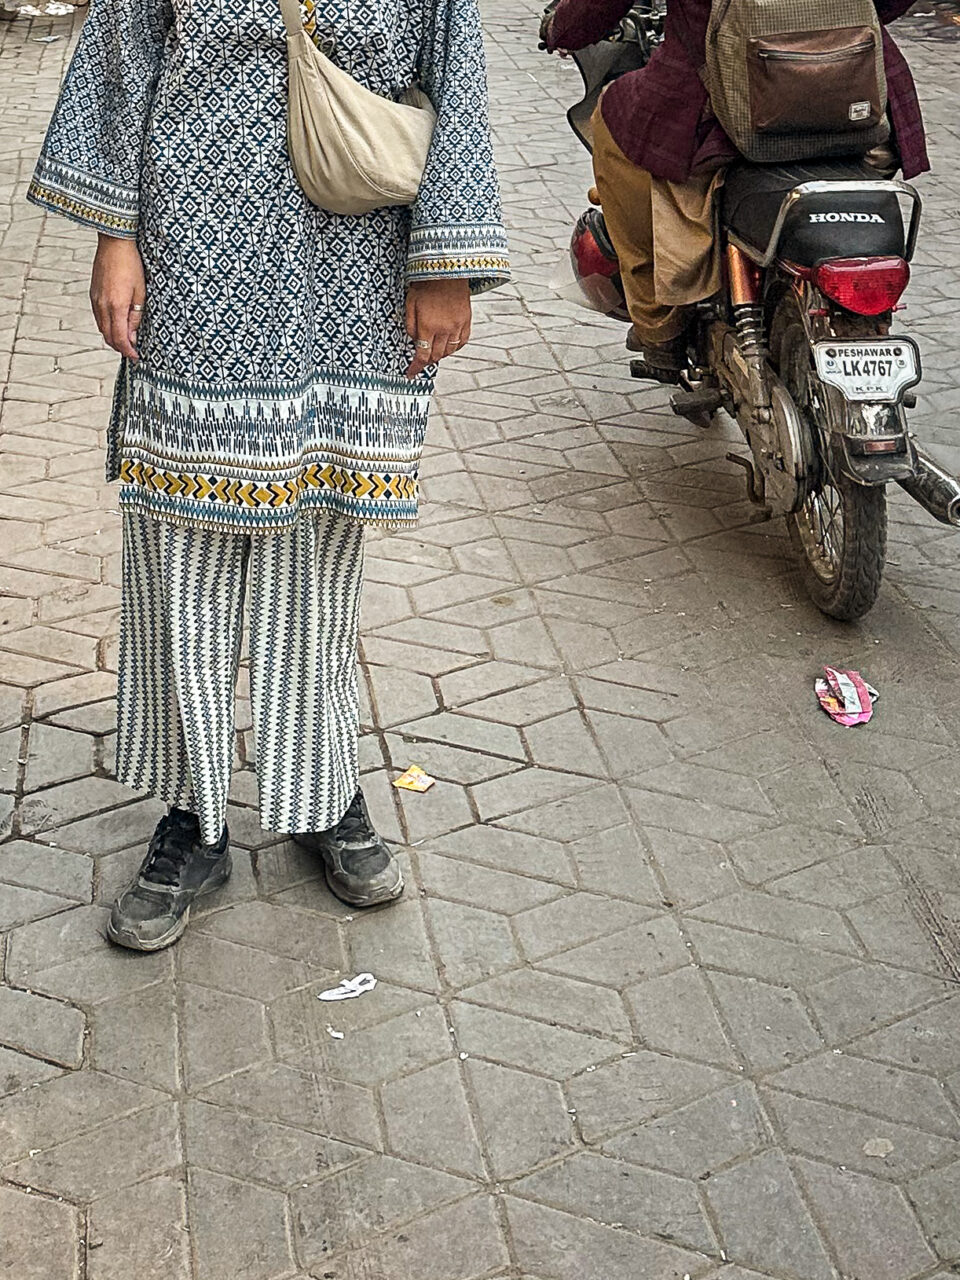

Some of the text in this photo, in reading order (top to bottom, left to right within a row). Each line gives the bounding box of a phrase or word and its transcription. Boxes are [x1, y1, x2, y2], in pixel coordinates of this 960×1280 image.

[809, 213, 885, 224] HONDA
[838, 348, 892, 357] PESHAWAR
[843, 360, 892, 377] LK4767
